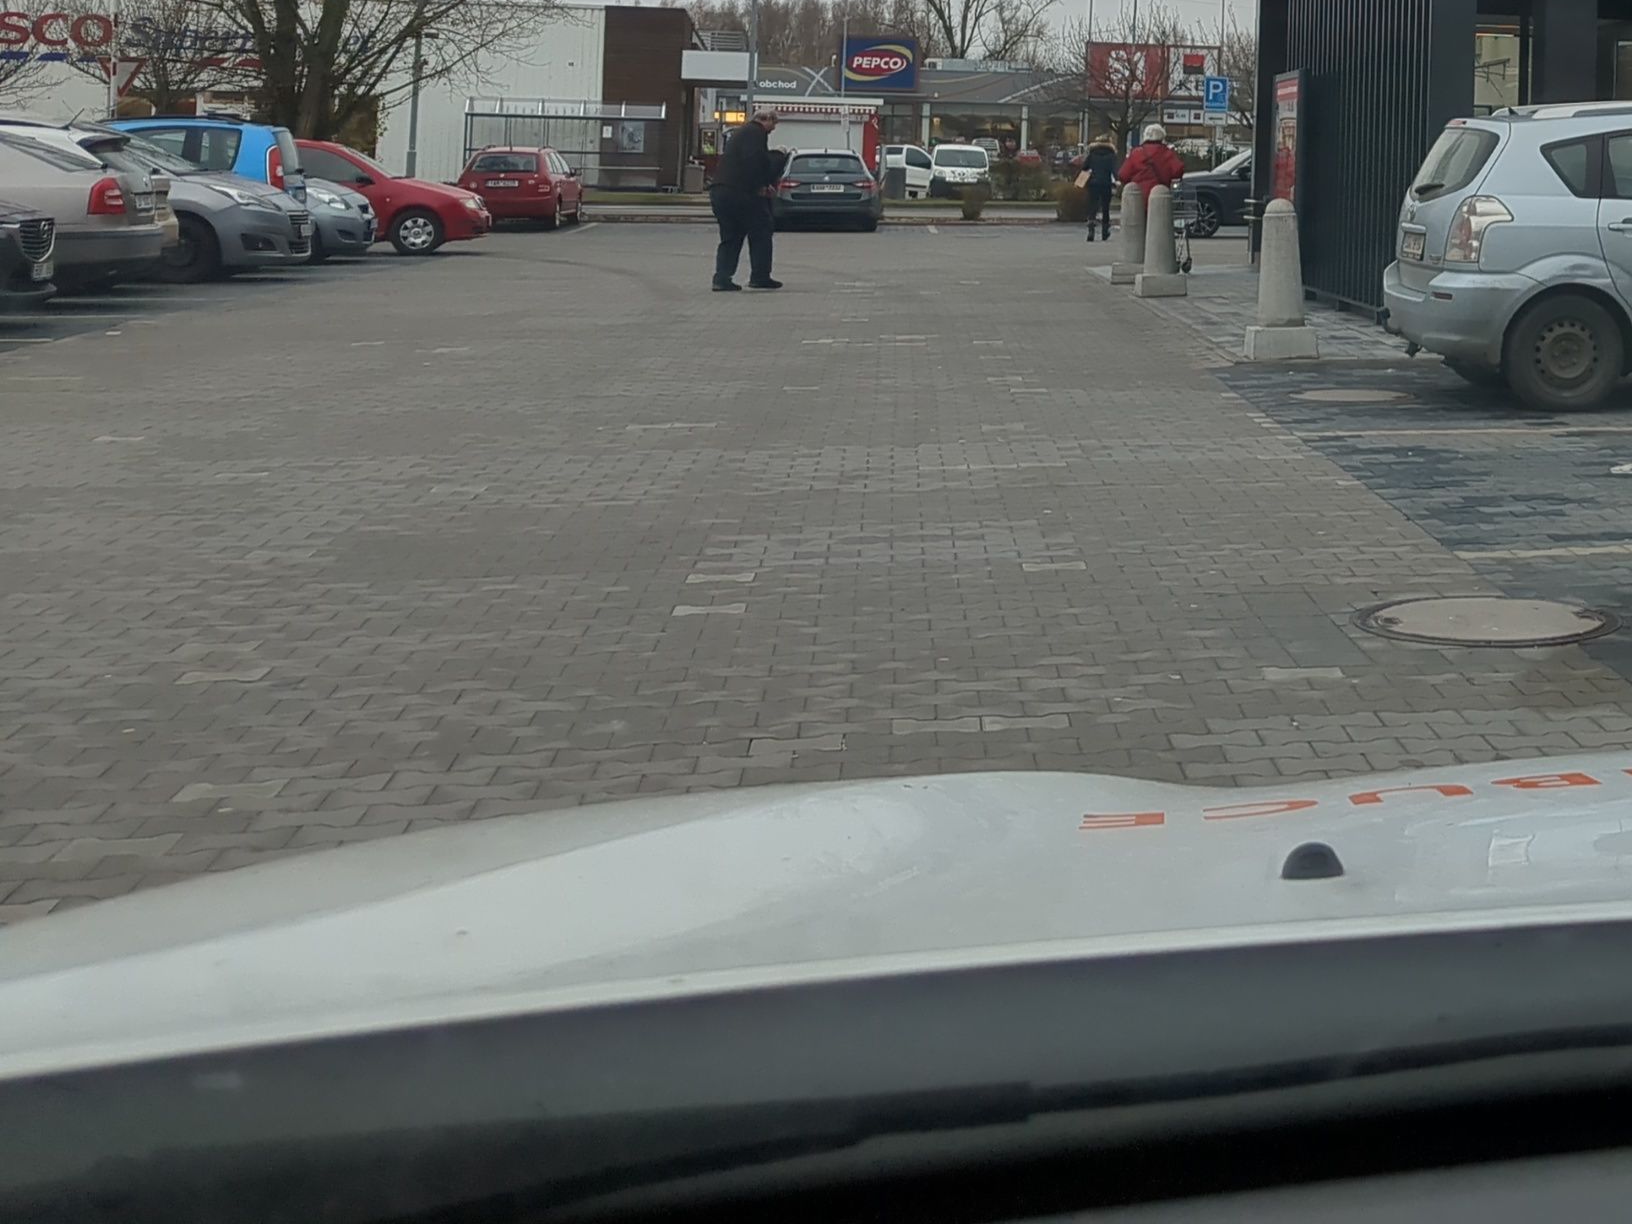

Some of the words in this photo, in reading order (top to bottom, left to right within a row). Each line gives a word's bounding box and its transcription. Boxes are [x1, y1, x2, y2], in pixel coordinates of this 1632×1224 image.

[852, 56, 902, 69] PEPCO
[759, 79, 797, 89] obchod
[1208, 80, 1223, 100] P
